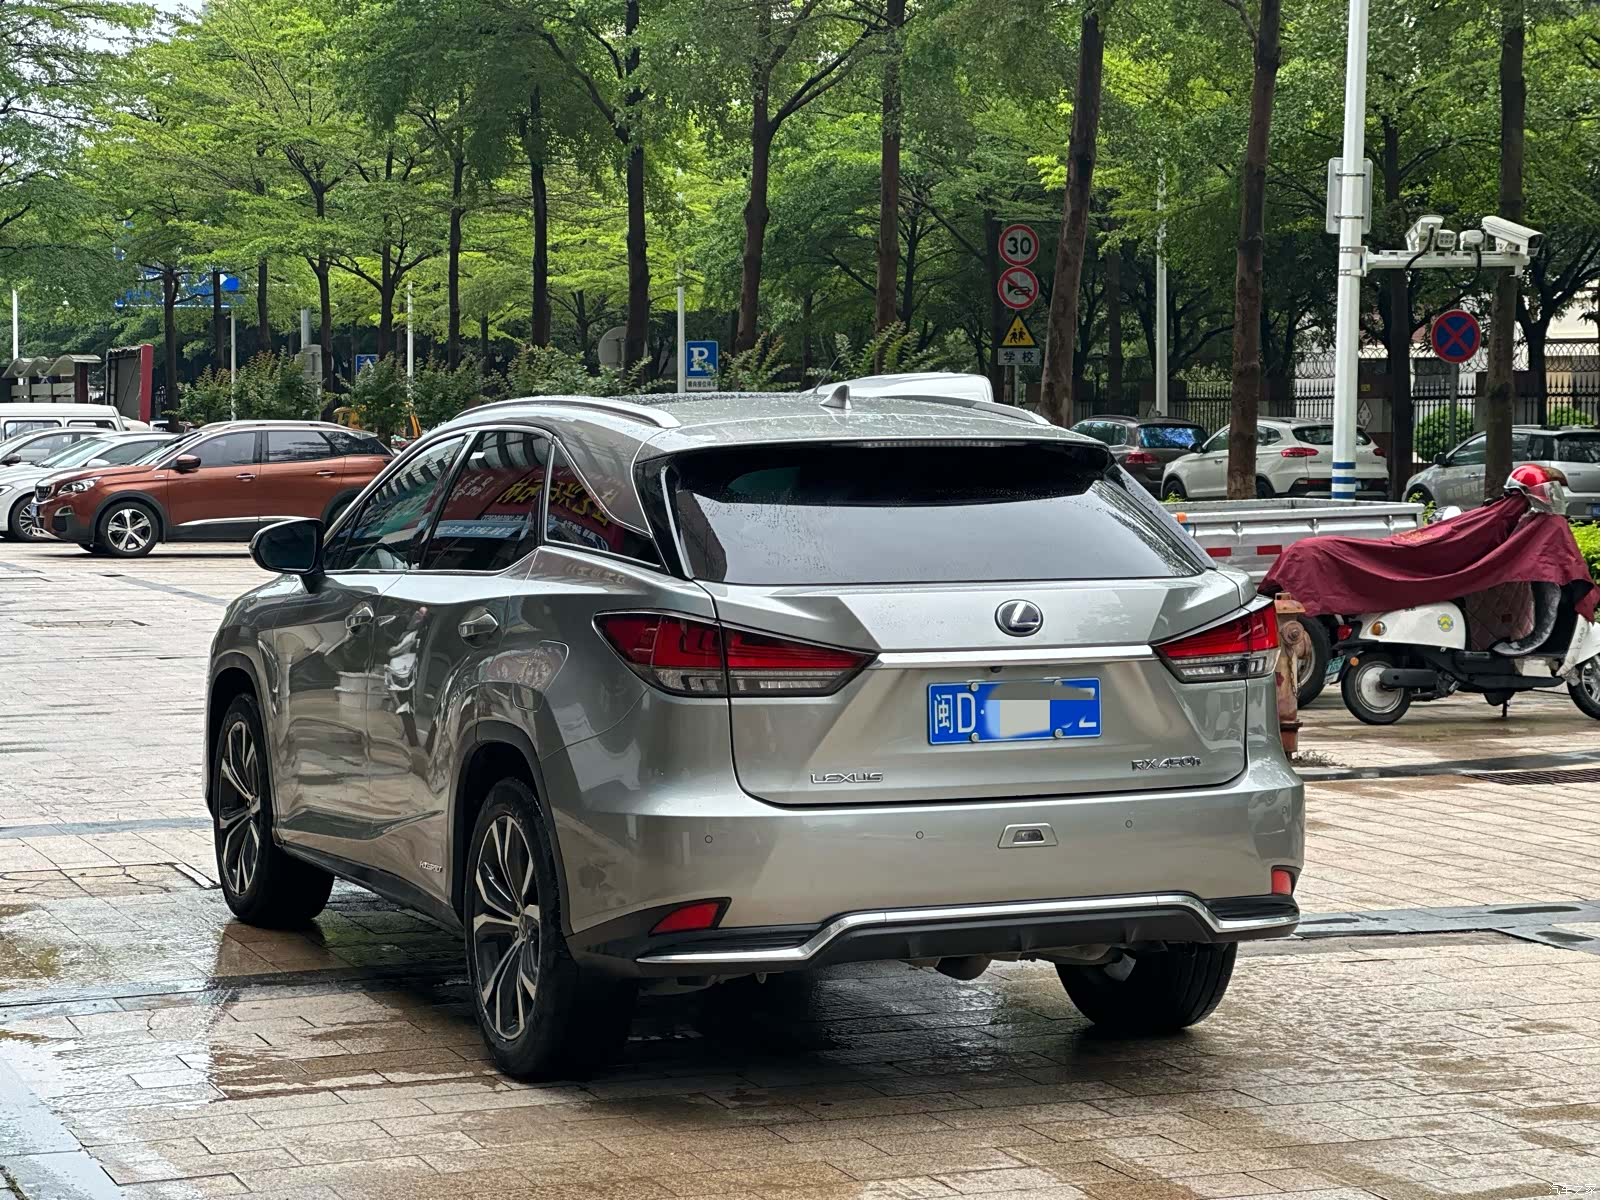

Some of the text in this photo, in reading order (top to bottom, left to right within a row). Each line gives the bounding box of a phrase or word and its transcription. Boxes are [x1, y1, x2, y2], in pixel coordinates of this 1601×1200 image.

[1007, 237, 1032, 255] 30
[689, 347, 709, 372] P
[1003, 350, 1034, 364] 学校
[1131, 758, 1157, 771] RX
[810, 772, 884, 785] LEXUS
